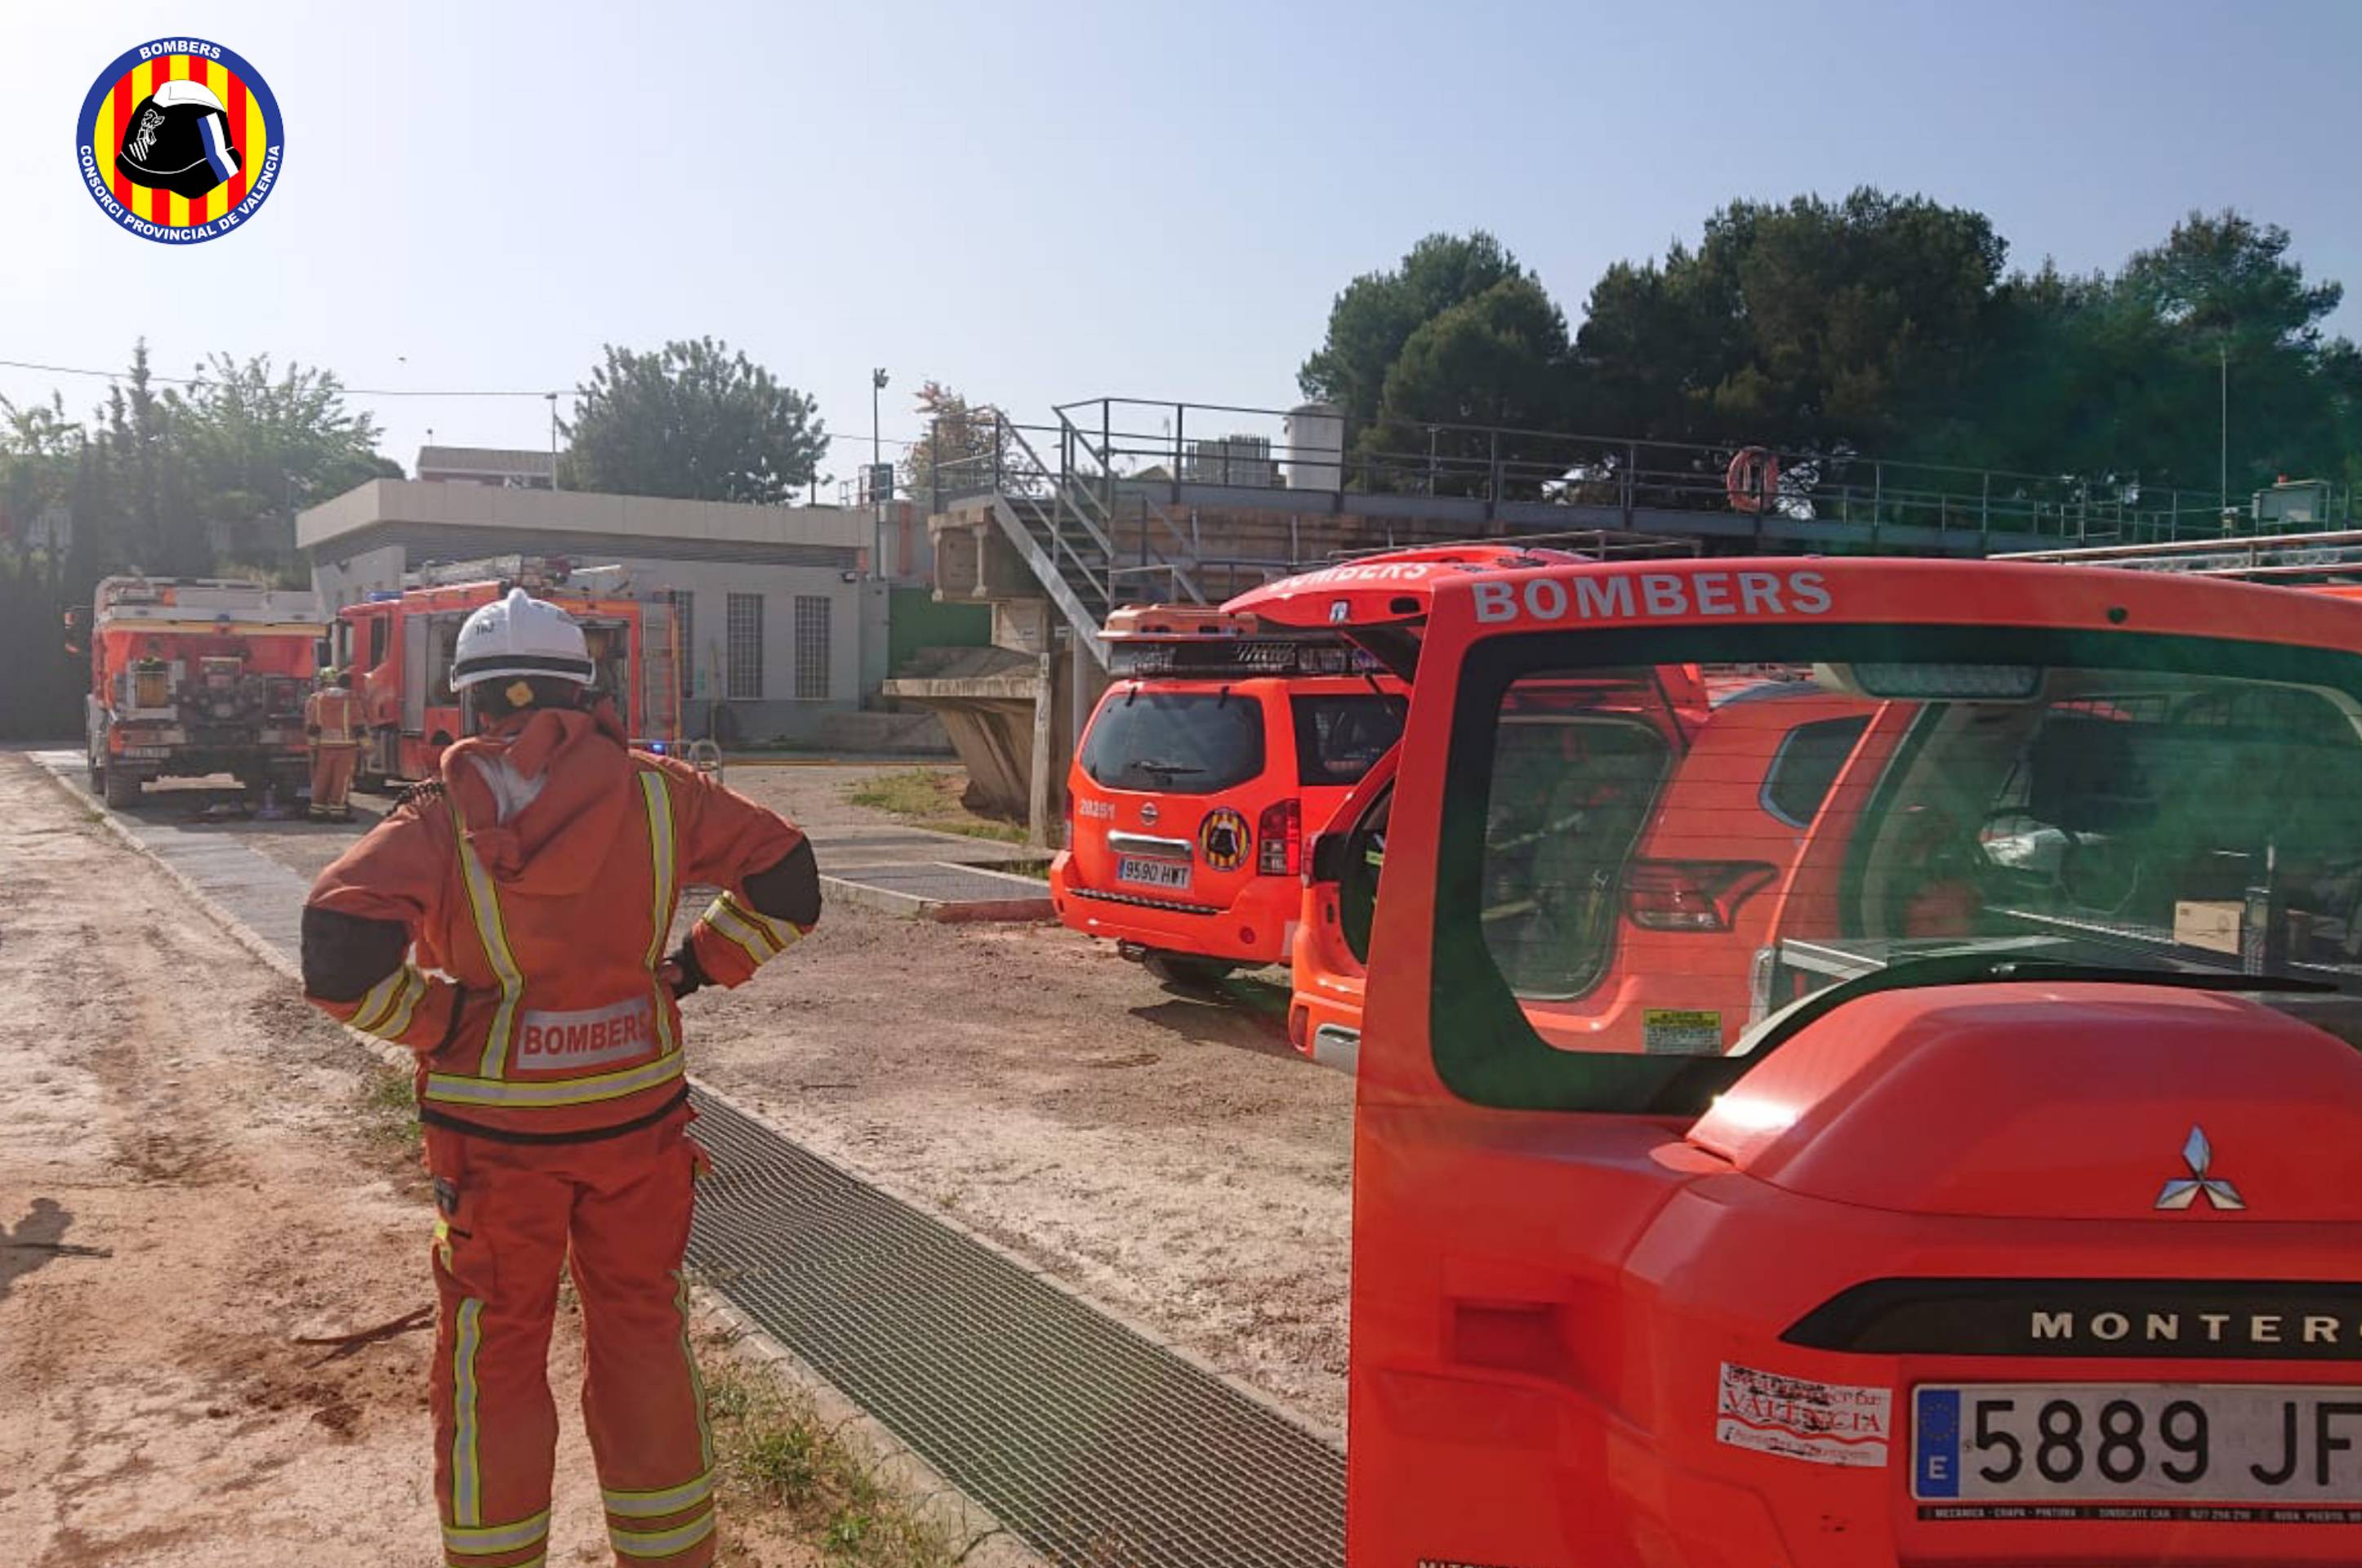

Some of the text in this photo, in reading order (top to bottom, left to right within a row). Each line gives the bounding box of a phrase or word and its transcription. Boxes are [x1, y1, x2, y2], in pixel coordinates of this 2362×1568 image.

[1473, 571, 1833, 623] BOMBERS
[1125, 861, 1158, 882] 9590
[523, 1011, 650, 1056] BOMBERS
[2031, 1312, 2362, 1343] MONTER
[1975, 1399, 2362, 1486] 5889 JF
[1928, 1455, 1948, 1480] E
